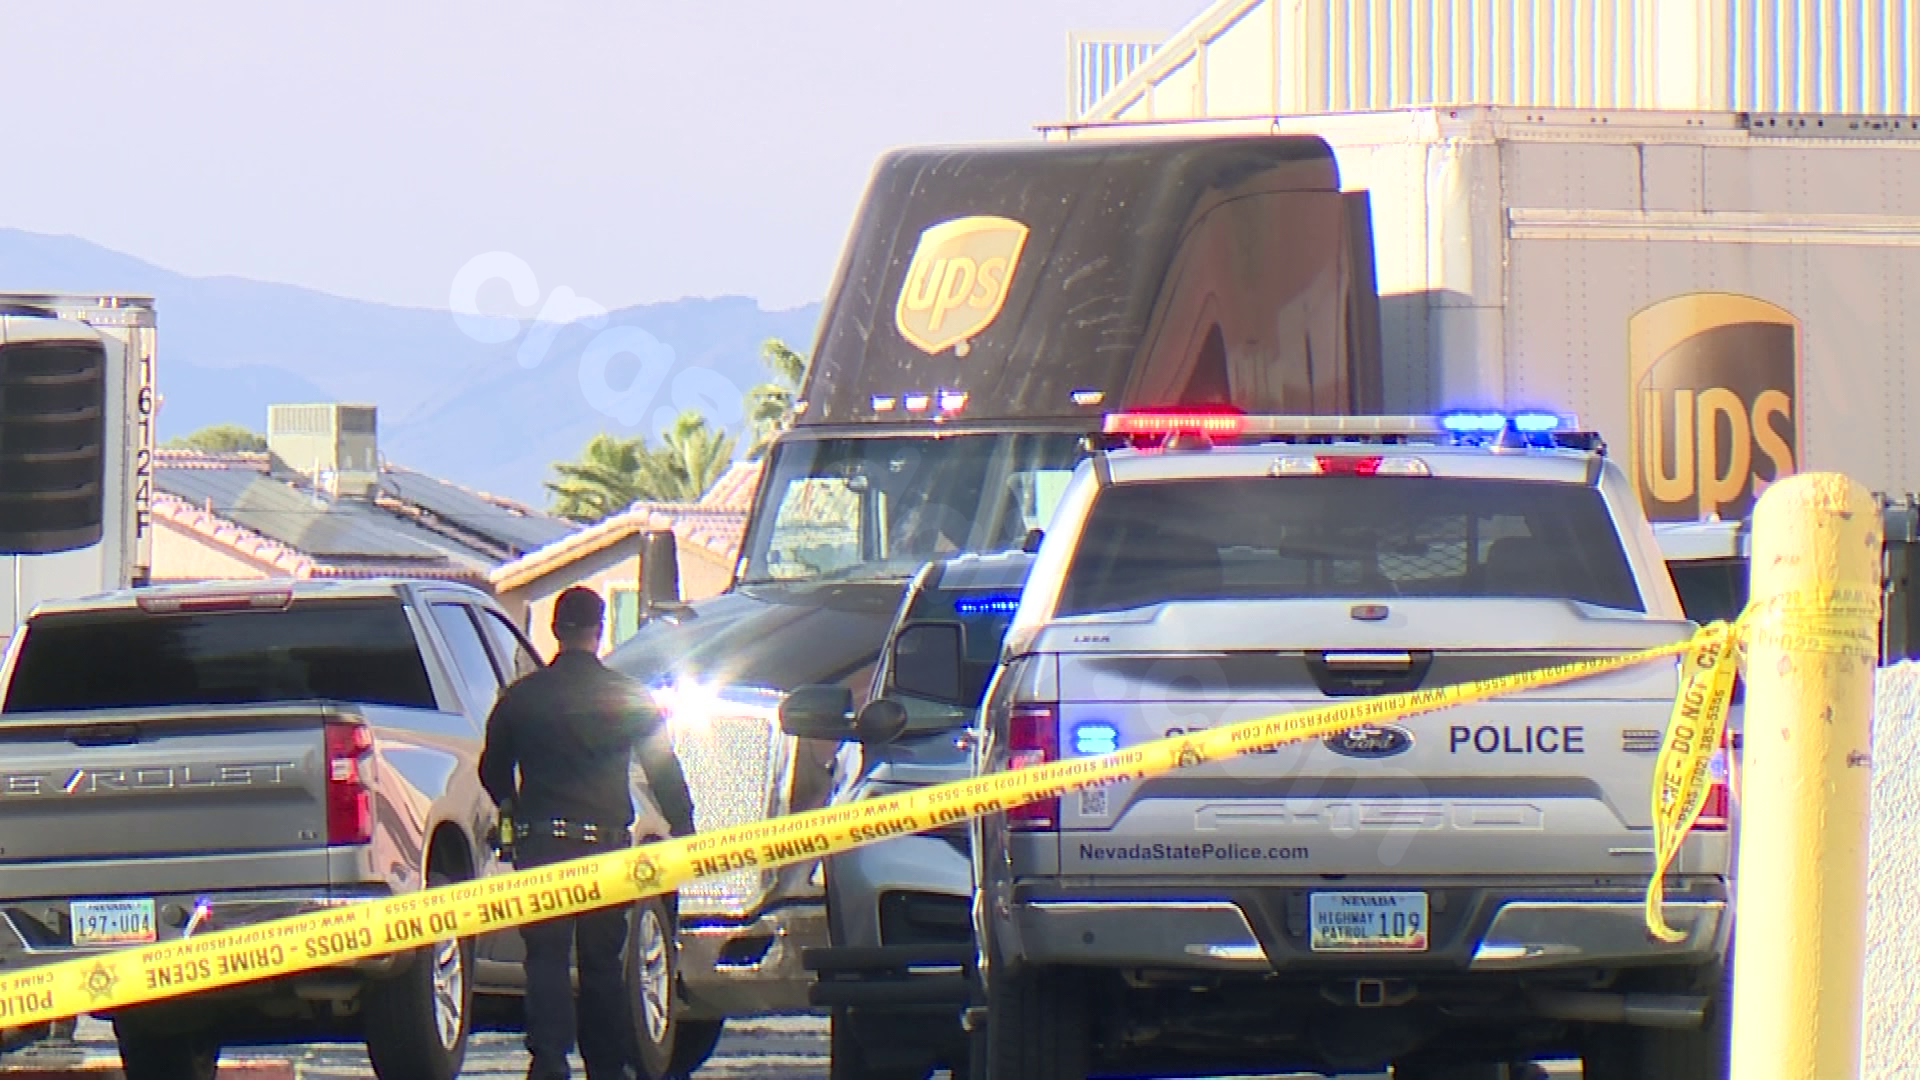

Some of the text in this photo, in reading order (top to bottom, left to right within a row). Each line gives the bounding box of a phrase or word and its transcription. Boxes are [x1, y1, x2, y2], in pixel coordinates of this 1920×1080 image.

[136, 354, 151, 538] 16124F
[1450, 725, 1585, 753] POLICE
[850, 815, 918, 843] CROSS
[762, 833, 830, 863] CRIME
[1079, 843, 1309, 860] NevadaStatePolice.com
[557, 863, 600, 882] CRIME
[690, 847, 758, 878] SCENE
[451, 885, 484, 903] (702)
[492, 873, 554, 893] STOPPERS
[530, 880, 601, 913] POLICE
[478, 898, 524, 925] LINE
[1342, 895, 1397, 907] NEVADA
[384, 917, 424, 944] NOT
[429, 909, 458, 935] DO
[1318, 911, 1374, 924] HIGHWAY
[1380, 911, 1420, 937] 109
[305, 927, 373, 959] CROSS
[1322, 925, 1367, 938] PATROL
[146, 959, 211, 989] SCENE
[218, 945, 285, 978] CRIME
